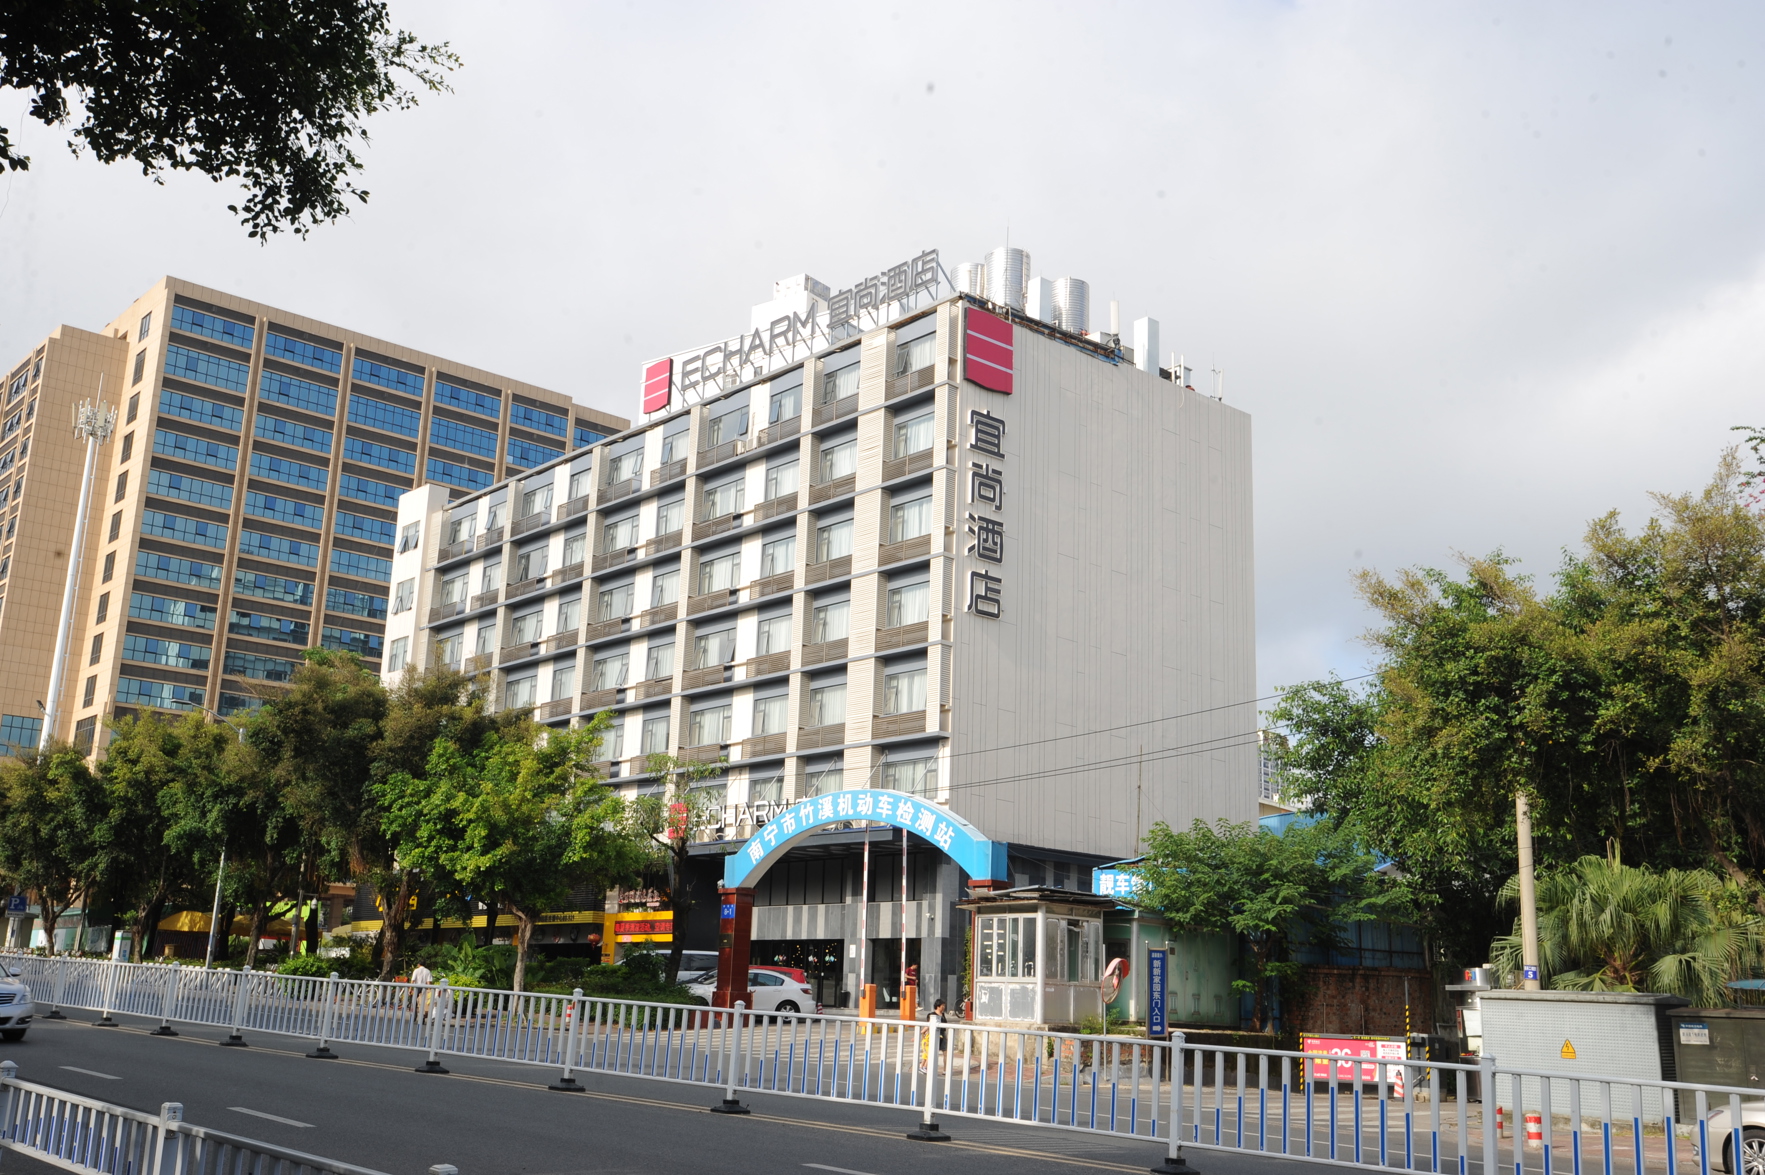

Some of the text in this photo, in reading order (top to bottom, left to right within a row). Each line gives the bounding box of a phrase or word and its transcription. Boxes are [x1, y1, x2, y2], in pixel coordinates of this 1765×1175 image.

[827, 248, 940, 329] 宜尚酒店
[680, 301, 817, 392] ECHARM
[967, 408, 1007, 620] 宜尚酒店
[747, 793, 956, 865] 南宁市竹溪机动车检测站
[1152, 959, 1162, 1023] 新新家园东门入口
